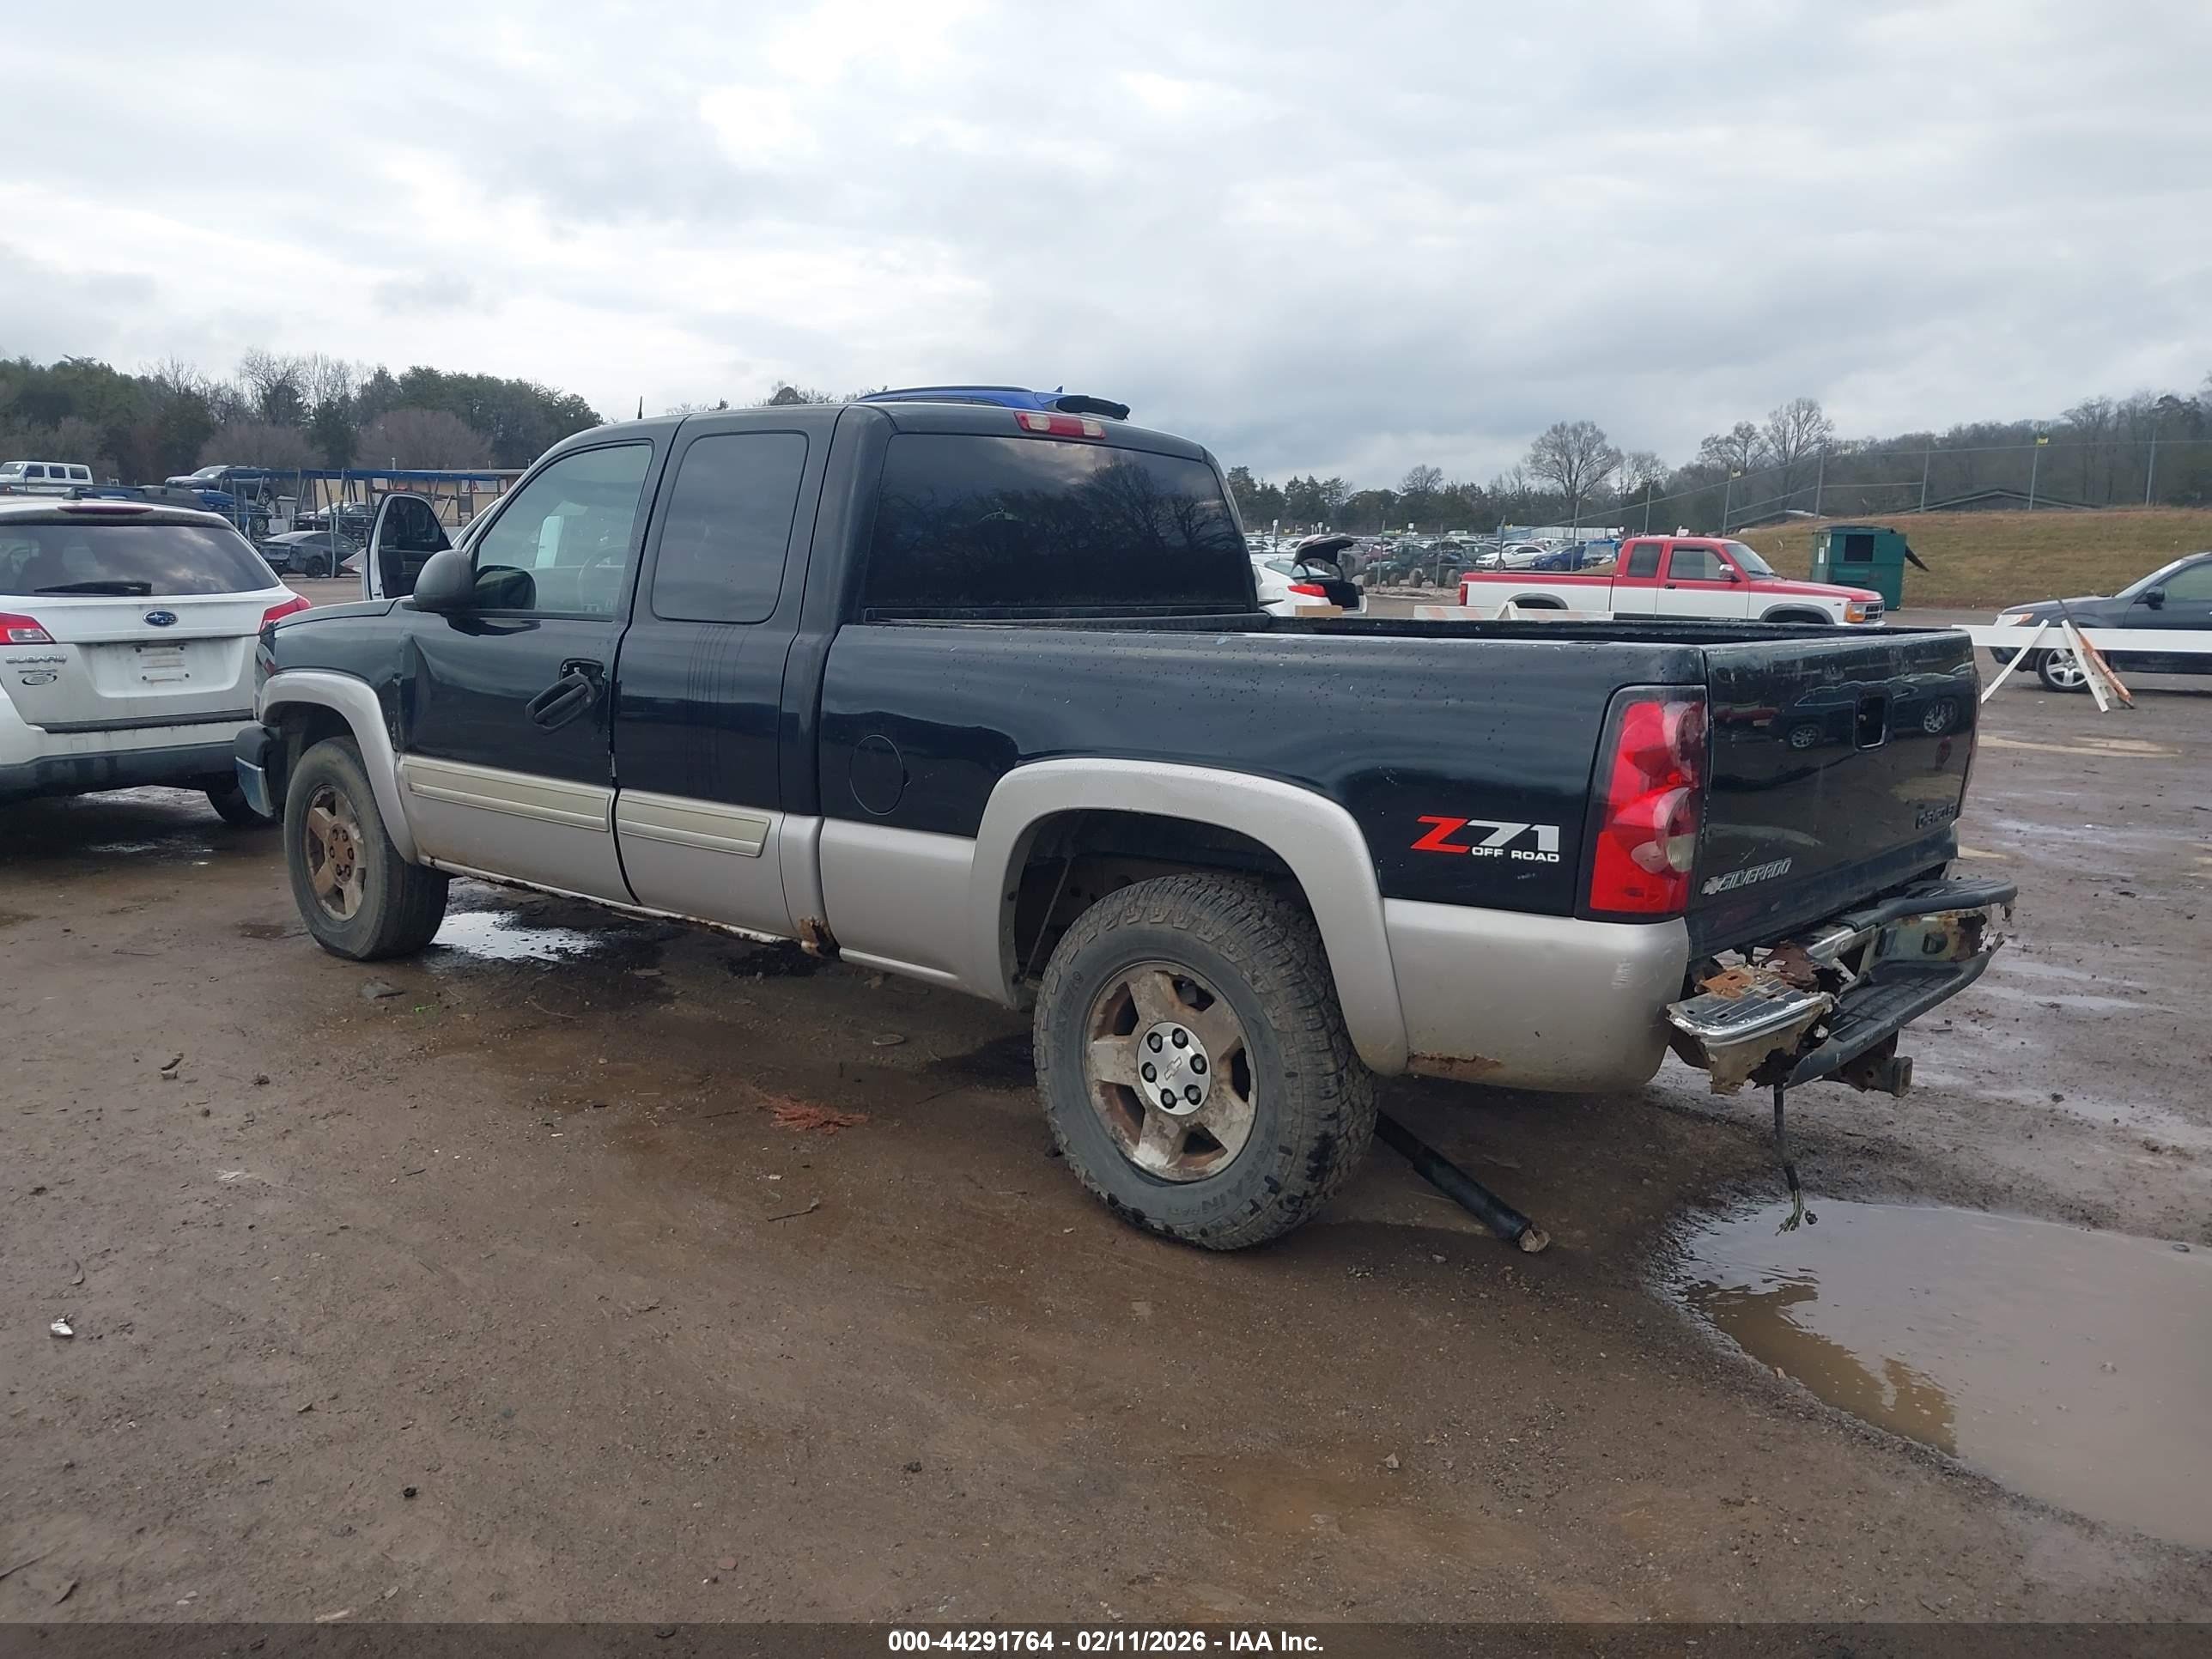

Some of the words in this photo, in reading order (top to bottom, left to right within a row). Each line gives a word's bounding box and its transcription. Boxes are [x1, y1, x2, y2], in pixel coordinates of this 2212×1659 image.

[6, 655, 67, 665] SUBARU
[1410, 816, 1560, 854] Z71
[1472, 846, 1504, 858] OFF
[1511, 850, 1559, 863] ROAD
[1719, 857, 1792, 892] SILVERADO
